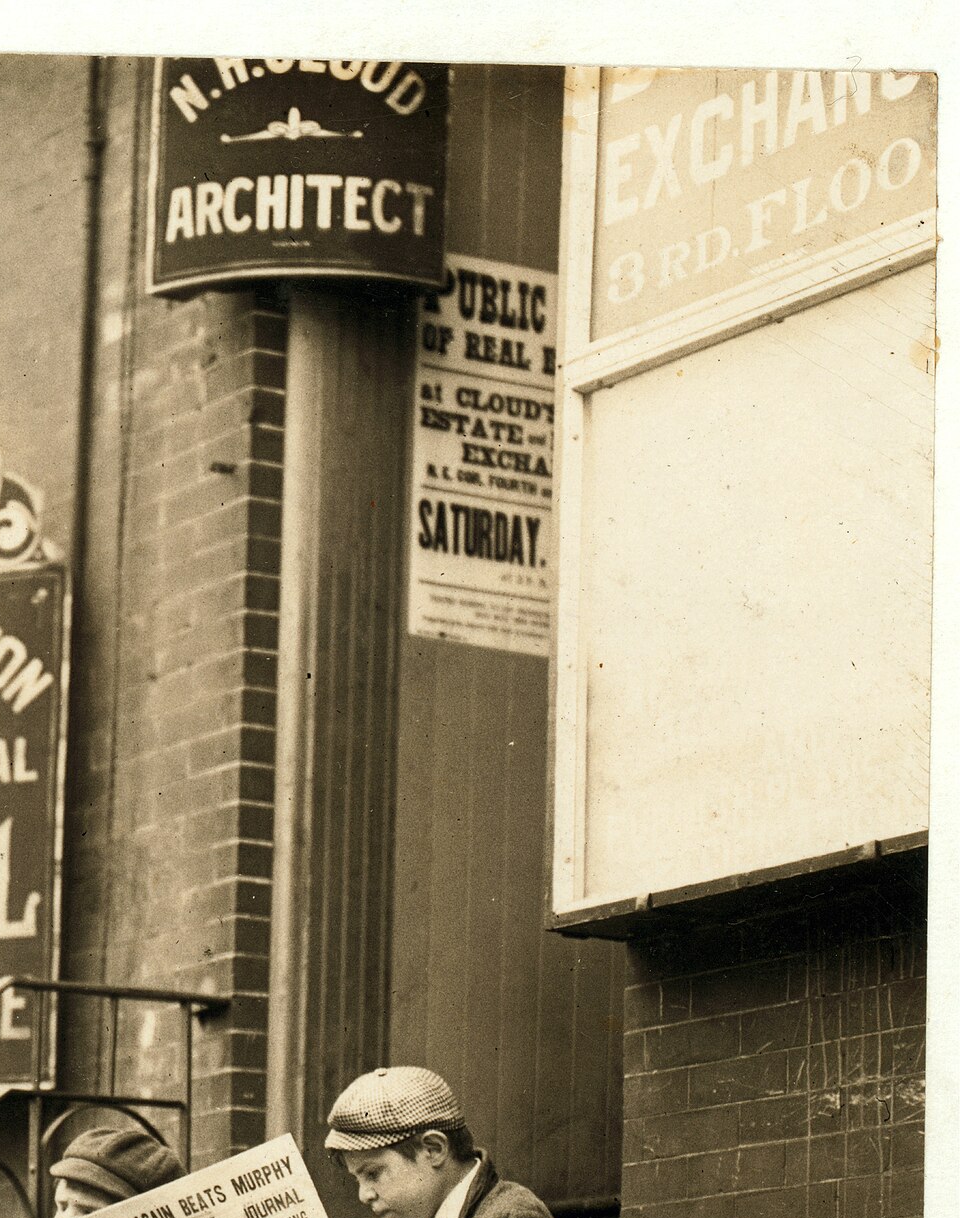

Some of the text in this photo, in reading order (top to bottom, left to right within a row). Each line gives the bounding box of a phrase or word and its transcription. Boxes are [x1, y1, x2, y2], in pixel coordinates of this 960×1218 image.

[166, 174, 434, 243] ARCHITECT
[421, 322, 453, 355] OF
[465, 331, 531, 371] REAL
[421, 406, 524, 446] ESTATE
[418, 498, 547, 568] SATURDAY.
[178, 1184, 227, 1217] BEATS
[230, 1156, 294, 1197] MURPHY
